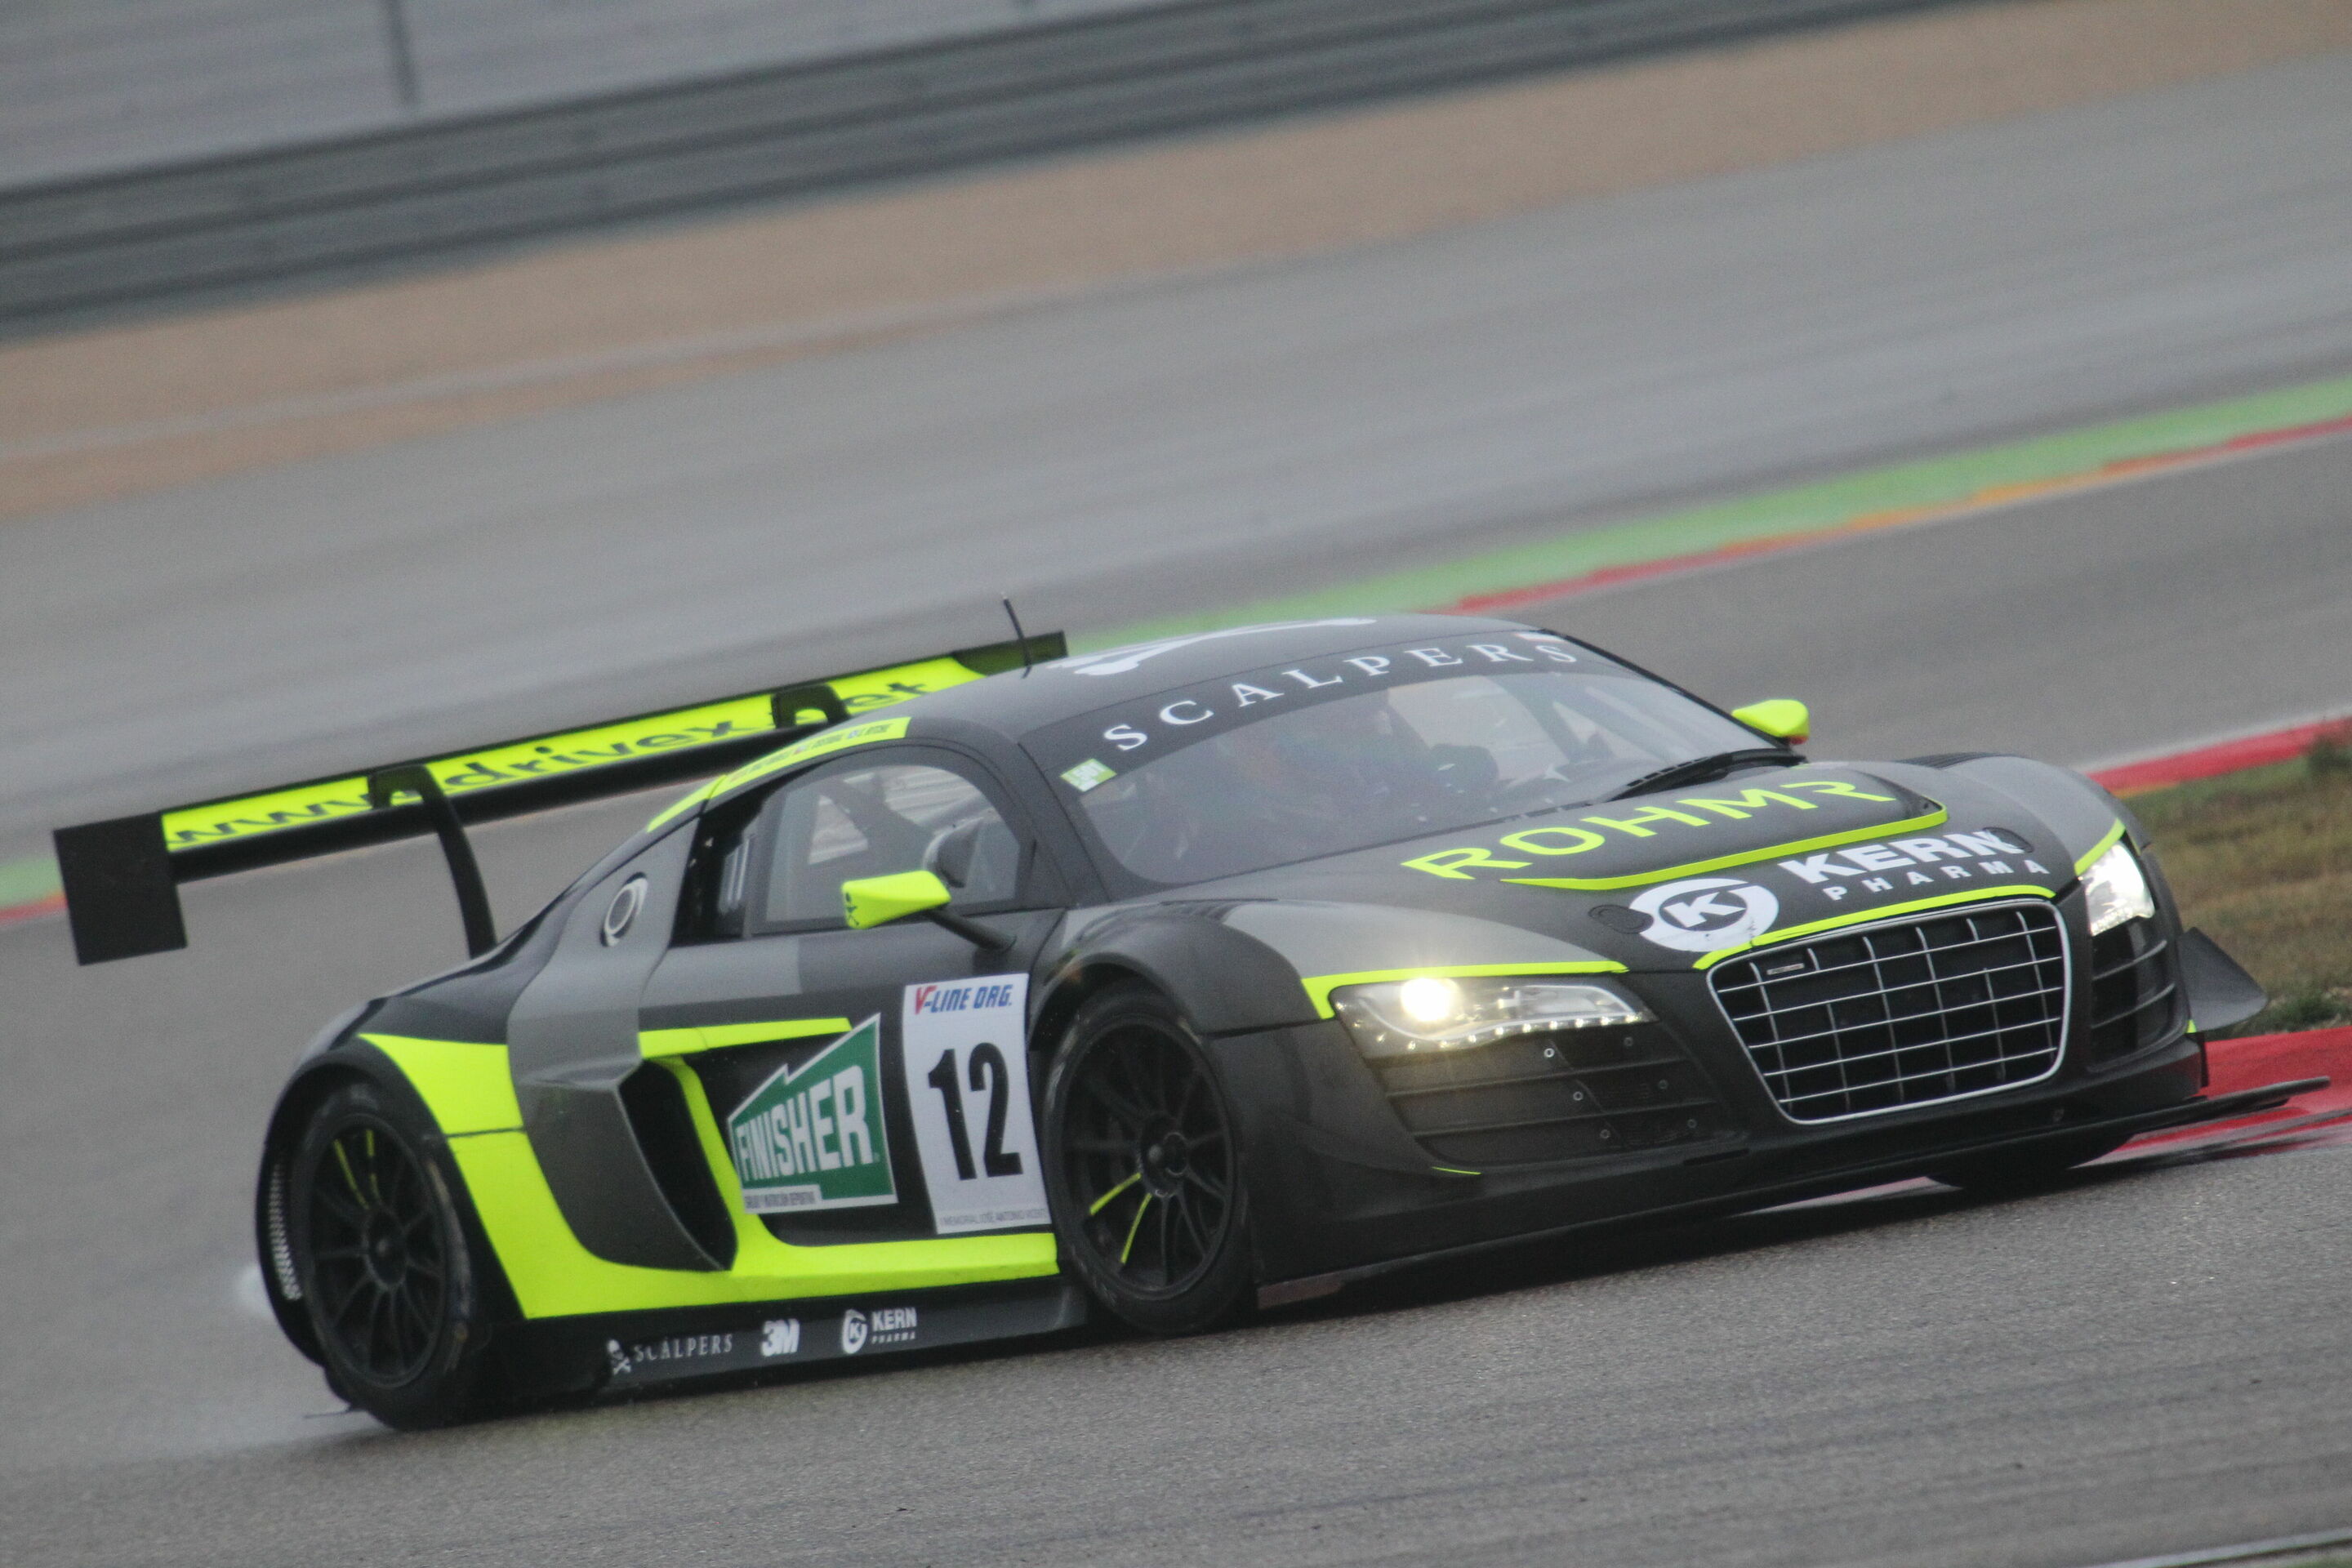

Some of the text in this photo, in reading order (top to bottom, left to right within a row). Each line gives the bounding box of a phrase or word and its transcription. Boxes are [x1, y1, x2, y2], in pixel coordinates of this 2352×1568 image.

[1103, 644, 1577, 751] SCALPERS
[1778, 831, 2025, 884] KERN
[1822, 860, 2050, 902] PHARMA
[915, 985, 973, 1014] V-LINE
[736, 1065, 874, 1183] FINISHER
[928, 1041, 1024, 1181] 12
[760, 1318, 800, 1357] 3M
[871, 1307, 917, 1332] KERN
